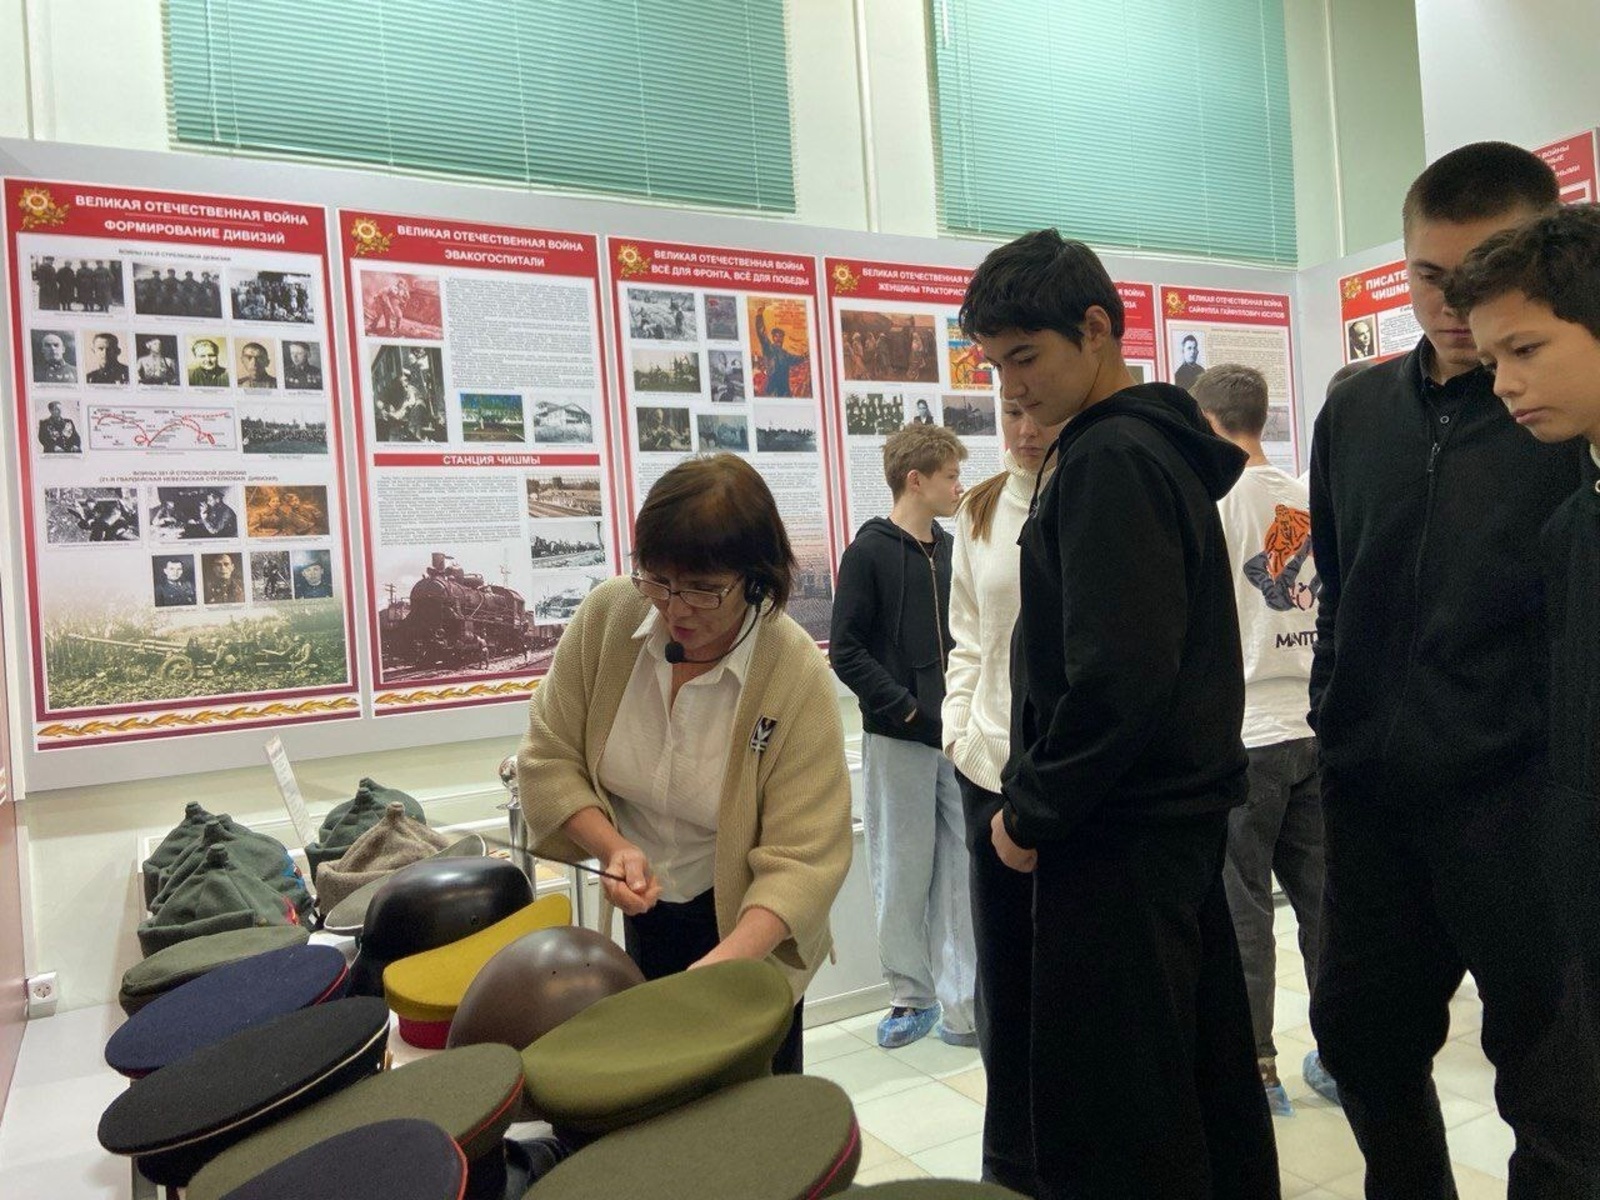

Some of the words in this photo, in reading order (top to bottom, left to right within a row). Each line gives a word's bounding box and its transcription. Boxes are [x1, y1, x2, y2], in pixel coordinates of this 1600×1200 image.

[75, 194, 141, 211] ВЕЛИКАЯ
[144, 202, 260, 222] ОТЕЧЕСТВЕННАЯ
[263, 209, 309, 226] ВОЙНА
[104, 219, 220, 239] ФОРМИРОВАНИЕ
[223, 229, 286, 245] ДИВИЗИЙ
[397, 224, 450, 240] ВЕЛИКАЯ
[453, 231, 546, 249] ОТЕЧЕСТВЕННАЯ
[548, 237, 584, 251] ВОЙНА
[444, 249, 545, 267] ЭВАКОГОСПИТАЛИ
[653, 249, 697, 262] ВЕЛИКАЯ
[699, 254, 774, 269] ОТЕЧЕСТВЕННАЯ
[775, 259, 805, 271] ВОЙНА
[651, 263, 670, 275] ВСЁ
[671, 266, 691, 277] ДЛЯ
[693, 267, 732, 281] ФРОНТА,
[734, 270, 751, 281] ВСЁ
[752, 273, 771, 284] ДЛЯ
[772, 275, 810, 286] ПОБЕДЫ
[862, 267, 899, 278] ВЕЛИКАЯ
[899, 271, 963, 283] ОТЕЧЕСТВЕННАЯ
[878, 282, 920, 293] ЖЕНЩИНЫ
[1124, 288, 1146, 298] ВОЙНА
[1188, 294, 1216, 303] ВЕЛИКАЯ
[1216, 296, 1263, 306] ОТЕЧЕСТВЕННАЯ
[1263, 298, 1283, 308] ВОЙНА
[442, 455, 495, 466] СТАНЦИЯ
[496, 455, 541, 465] ЧИШМЫ
